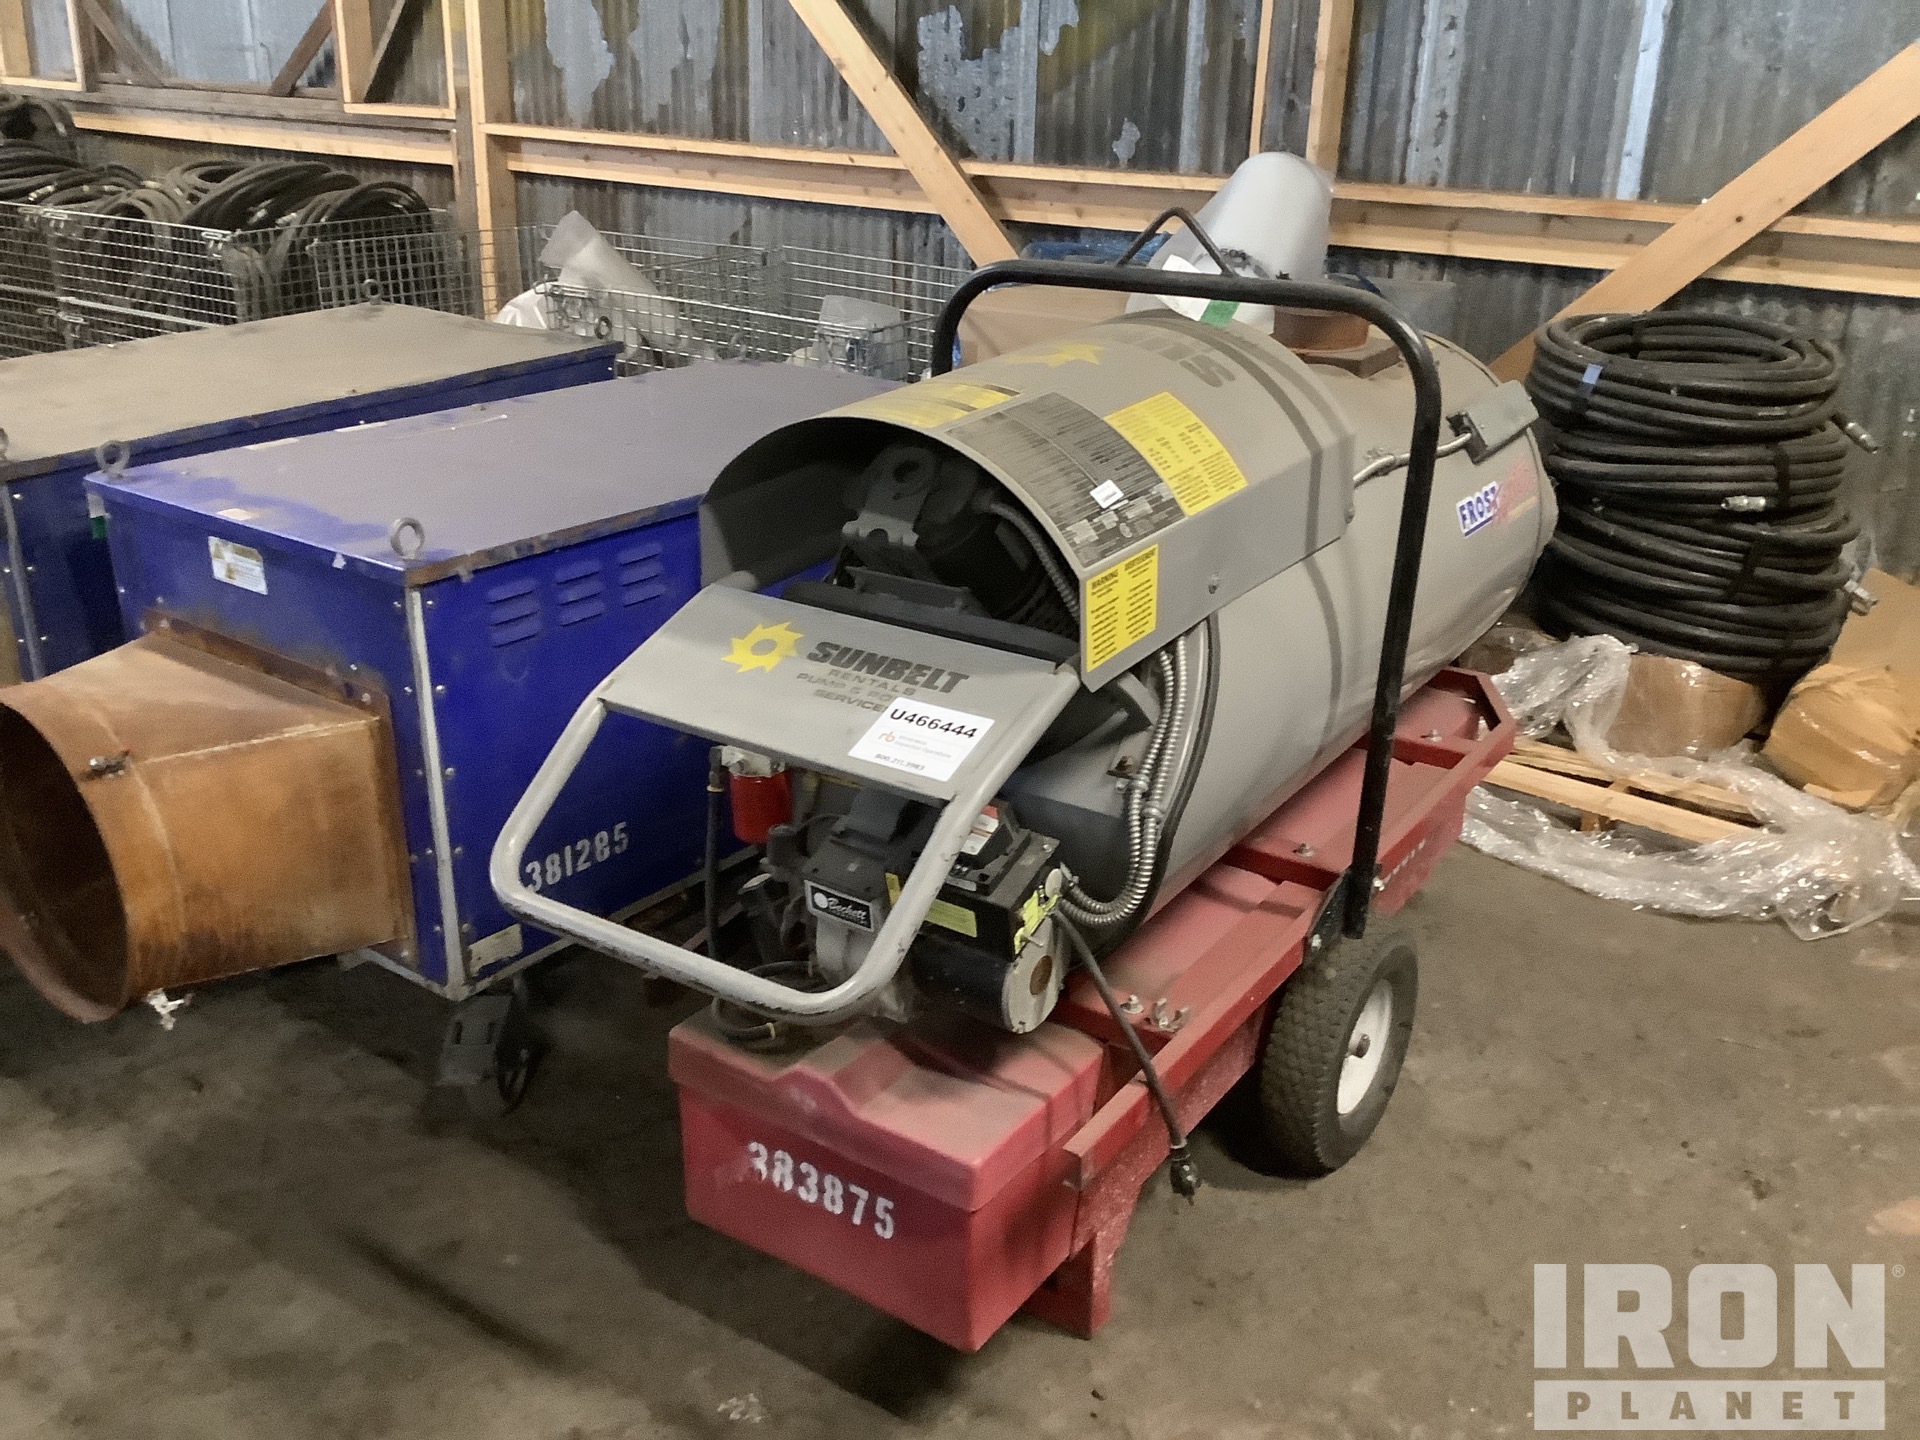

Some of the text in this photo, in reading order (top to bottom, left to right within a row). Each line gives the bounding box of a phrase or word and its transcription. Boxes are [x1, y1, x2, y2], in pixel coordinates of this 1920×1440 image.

[1458, 484, 1497, 530] FROS
[807, 641, 969, 693] SUNBELT
[828, 668, 916, 696] RENTALS
[889, 708, 978, 739] U466444
[525, 822, 628, 893] 381285
